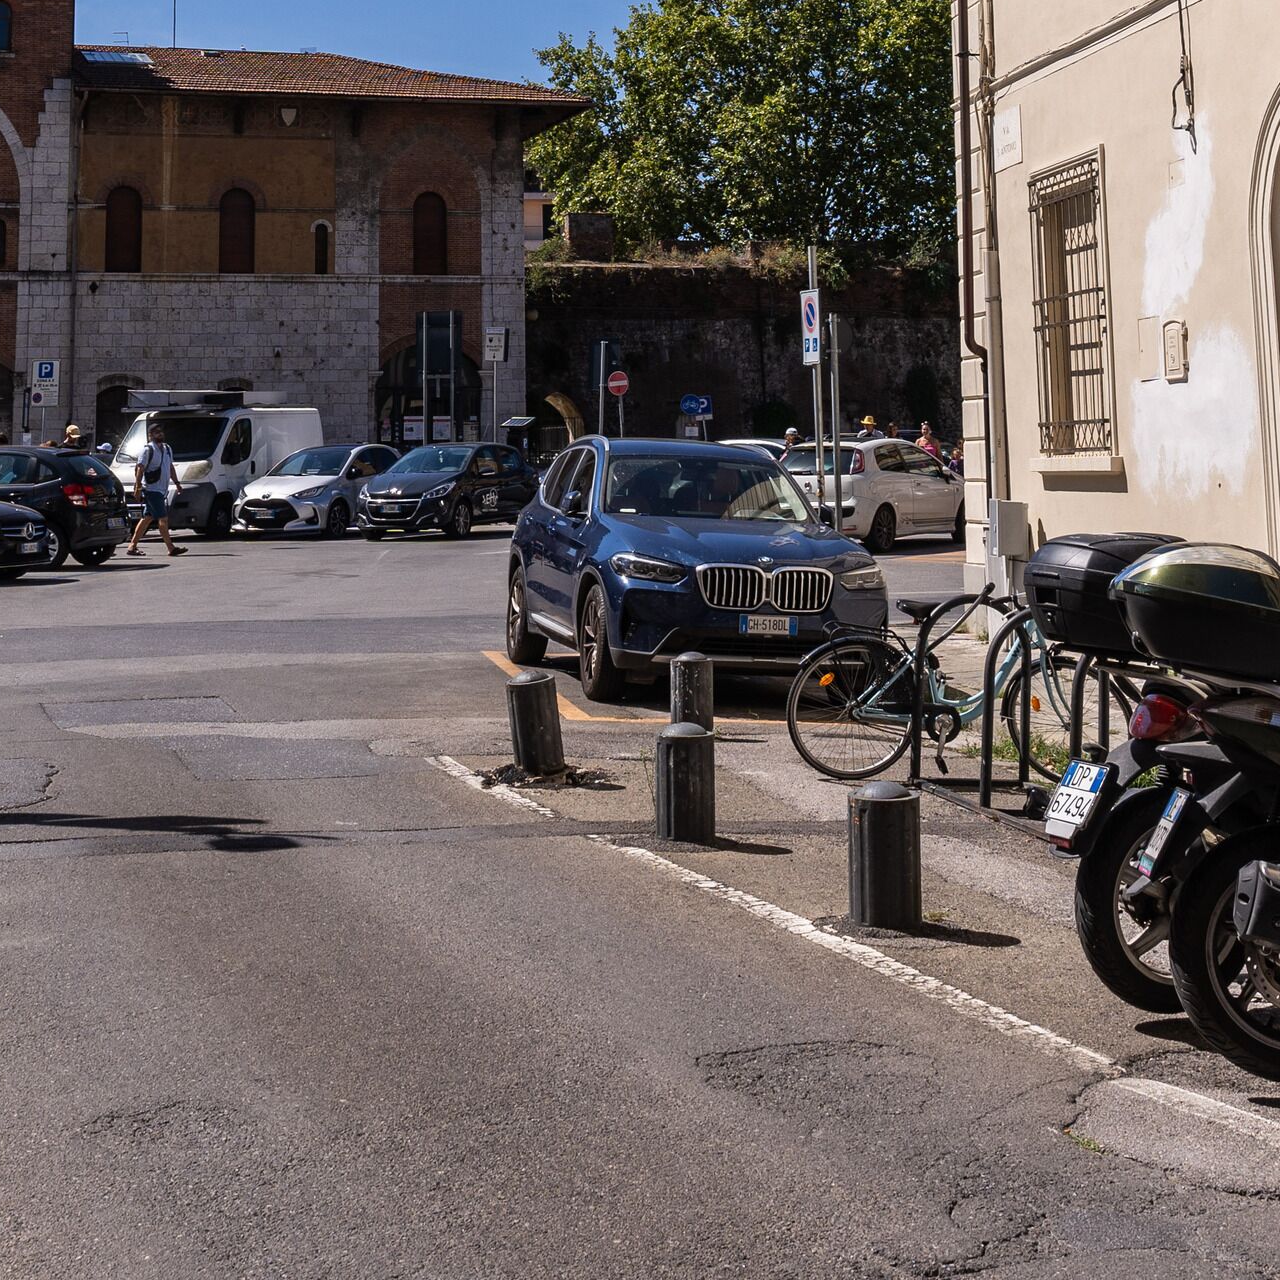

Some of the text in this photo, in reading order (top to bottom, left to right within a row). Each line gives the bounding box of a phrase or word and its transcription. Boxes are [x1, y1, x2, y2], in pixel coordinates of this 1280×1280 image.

[41, 363, 52, 377] P
[761, 619, 788, 631] 518DL
[1070, 765, 1091, 787] DP
[1051, 792, 1092, 820] 67494
